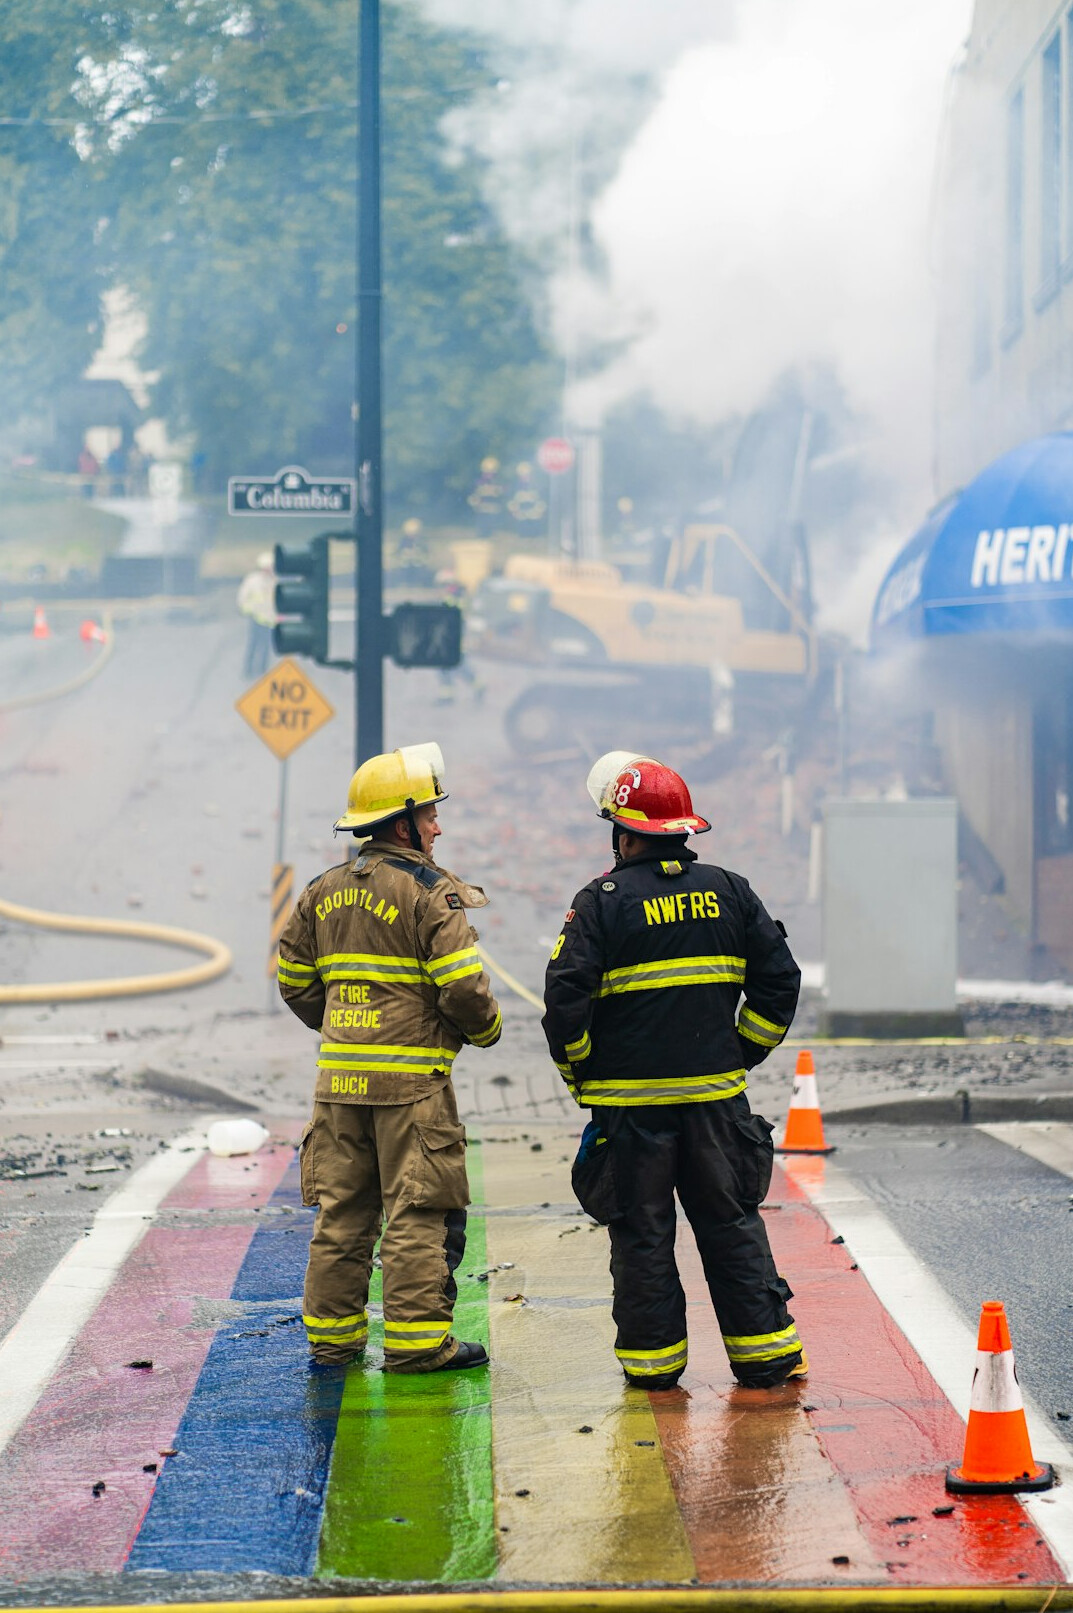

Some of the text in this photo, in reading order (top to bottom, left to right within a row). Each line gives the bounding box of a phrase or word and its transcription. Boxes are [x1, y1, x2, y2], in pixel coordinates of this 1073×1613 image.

[246, 484, 343, 509] Columbia
[970, 522, 1073, 588] HERI
[269, 680, 307, 702] NO
[259, 706, 312, 731] EXIT
[315, 888, 400, 926] COQUITLAM
[642, 891, 721, 926] NWFRS
[339, 985, 371, 1004] FIRE
[330, 1009, 382, 1029] RESCUE
[331, 1075, 368, 1095] BUCH
